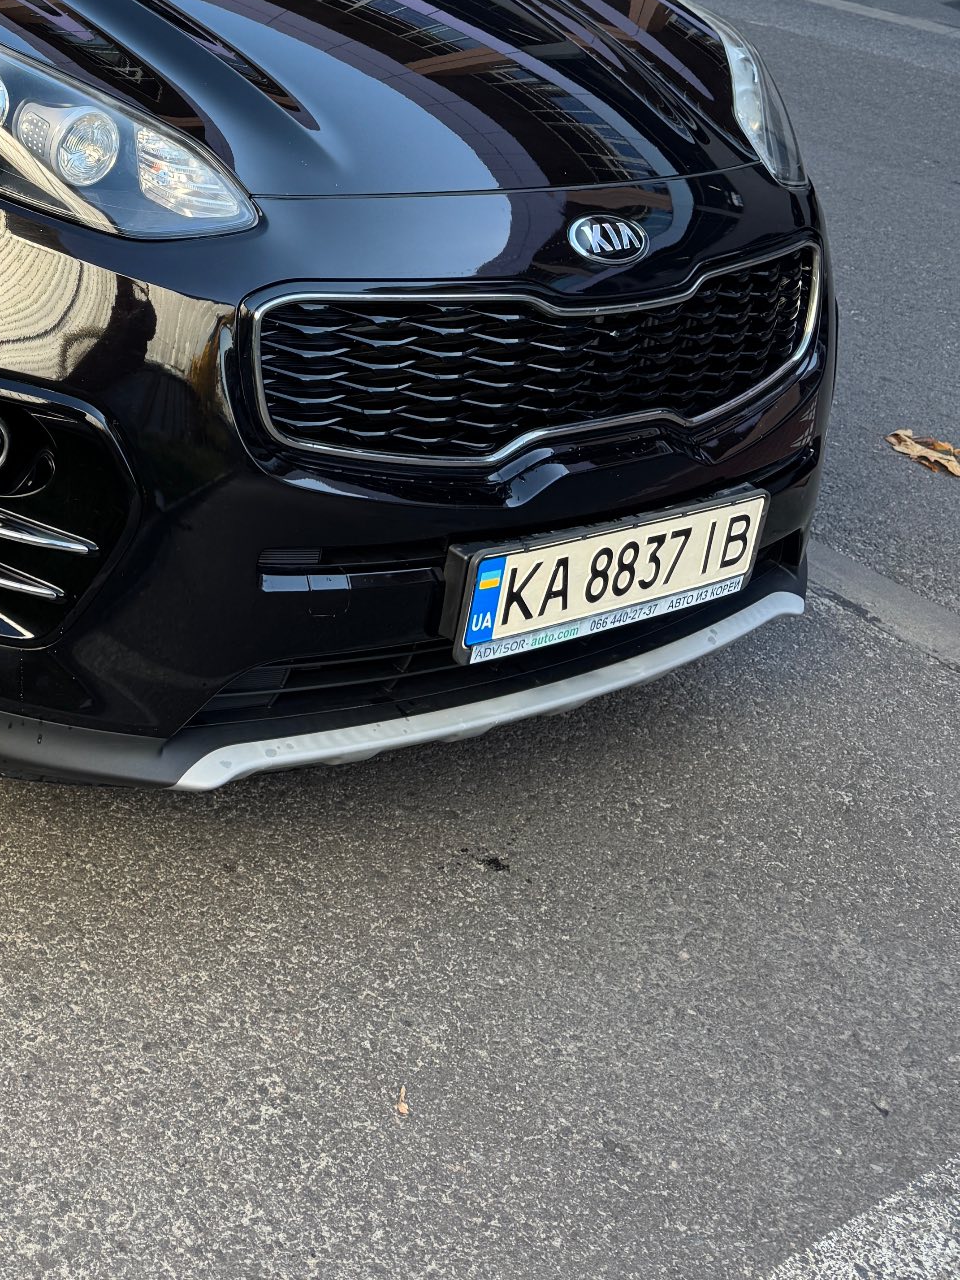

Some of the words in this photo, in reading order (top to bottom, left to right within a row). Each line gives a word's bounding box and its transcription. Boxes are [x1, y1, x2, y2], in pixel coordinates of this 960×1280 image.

[581, 222, 641, 253] KIA
[501, 556, 569, 626] KA
[585, 527, 693, 604] 8837
[701, 514, 751, 575] IB
[667, 595, 694, 611] АВТО
[695, 590, 709, 603] ИЗ
[709, 581, 741, 598] КОРЕИ
[471, 611, 492, 632] UA
[589, 617, 608, 632] 066
[609, 604, 658, 626] 440-27-37
